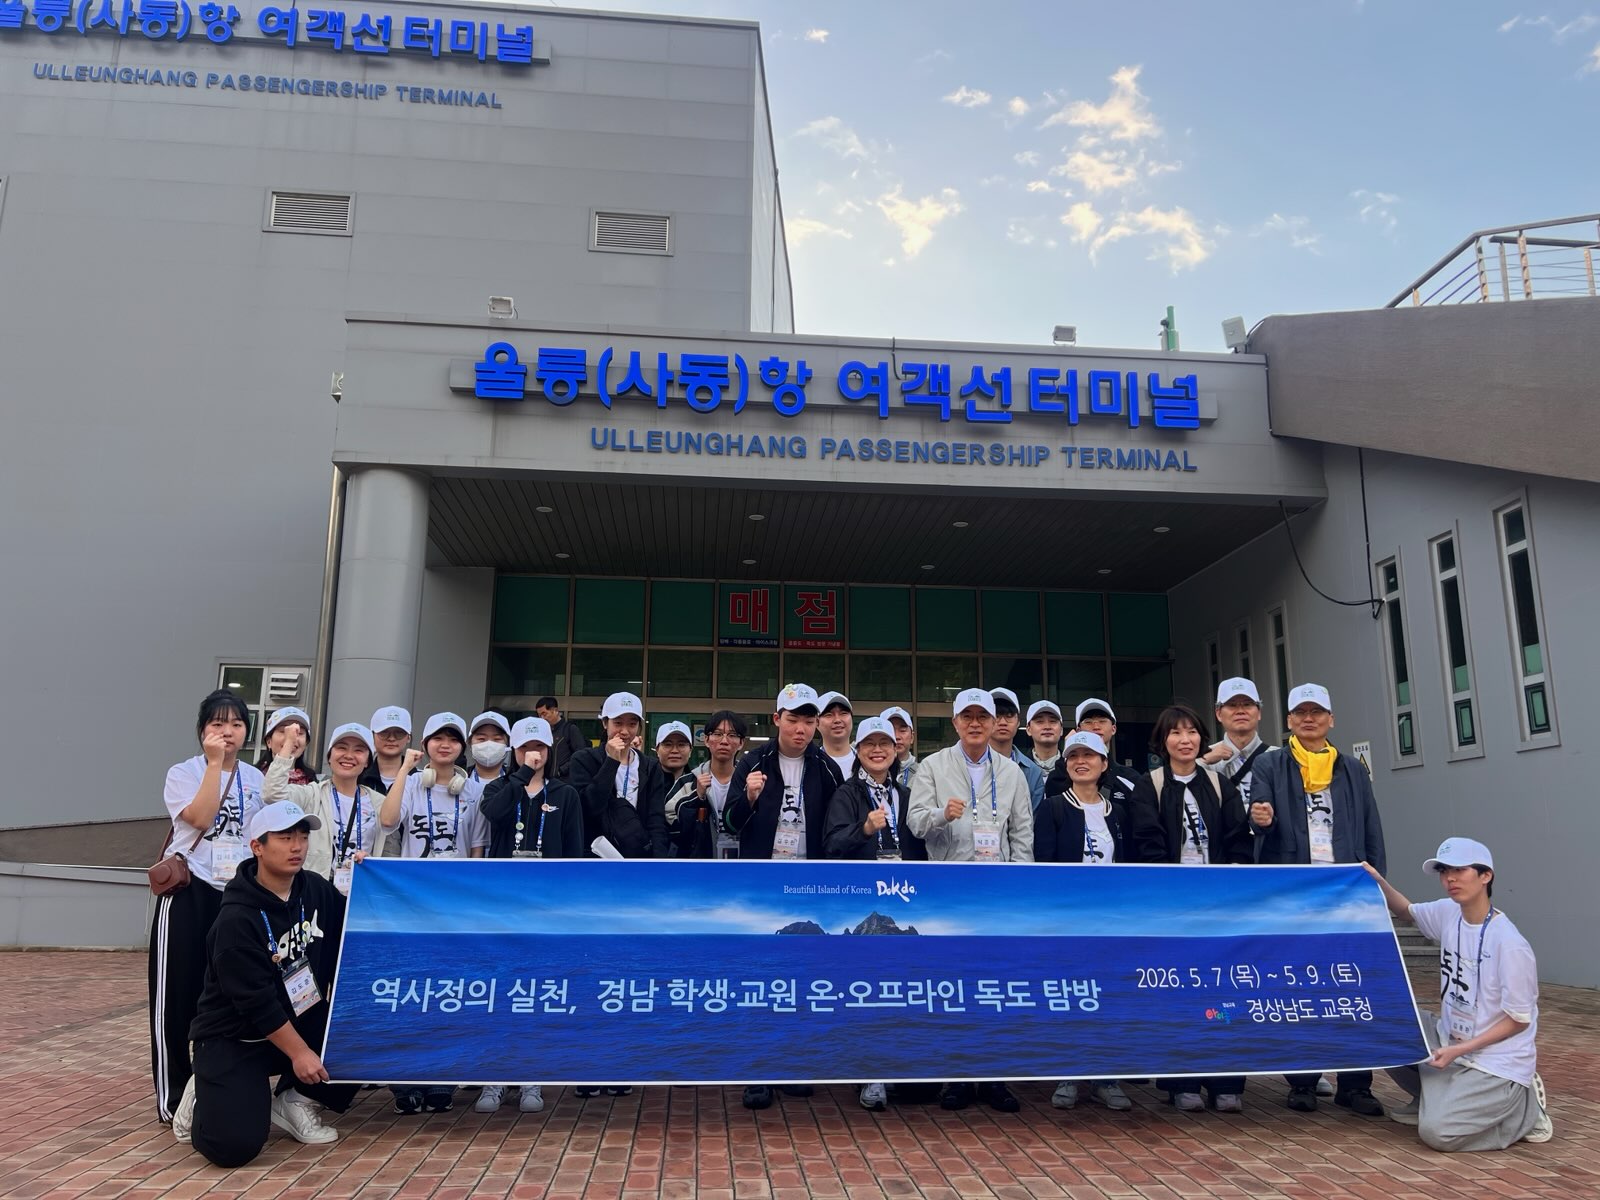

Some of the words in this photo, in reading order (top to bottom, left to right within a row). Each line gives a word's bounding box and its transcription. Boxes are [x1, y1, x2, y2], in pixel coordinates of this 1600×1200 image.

[257, 6, 392, 55] 여객선
[403, 16, 534, 64] 터미널
[33, 63, 198, 88] ULLEUNGHANG
[205, 73, 388, 100] PASSENGERSHIP
[396, 85, 502, 109] TERMINAL
[474, 342, 813, 417] 울릉(사동)항
[838, 361, 1013, 424] 여객선
[1029, 367, 1200, 430] 터미널
[591, 427, 807, 459] ULLEUNGHANG
[820, 438, 1050, 468] PASSENGERSHIP
[1062, 446, 1198, 472] TERMINAL
[783, 885, 816, 894] Beautiful
[818, 885, 840, 894] Island
[841, 885, 850, 894] of
[851, 885, 872, 894] Korea
[371, 977, 497, 1013] 역사정의
[507, 978, 577, 1015] 실천,
[597, 978, 660, 1013] 경남
[667, 978, 797, 1013] 학생·교원
[806, 979, 966, 1013] 온·오프라인
[974, 980, 1036, 1012] 독도
[1043, 979, 1102, 1012] 탐방
[1136, 967, 1185, 988] 2026.
[1211, 967, 1222, 987] 7
[1229, 965, 1261, 989] (목)
[1330, 962, 1362, 987] (토)
